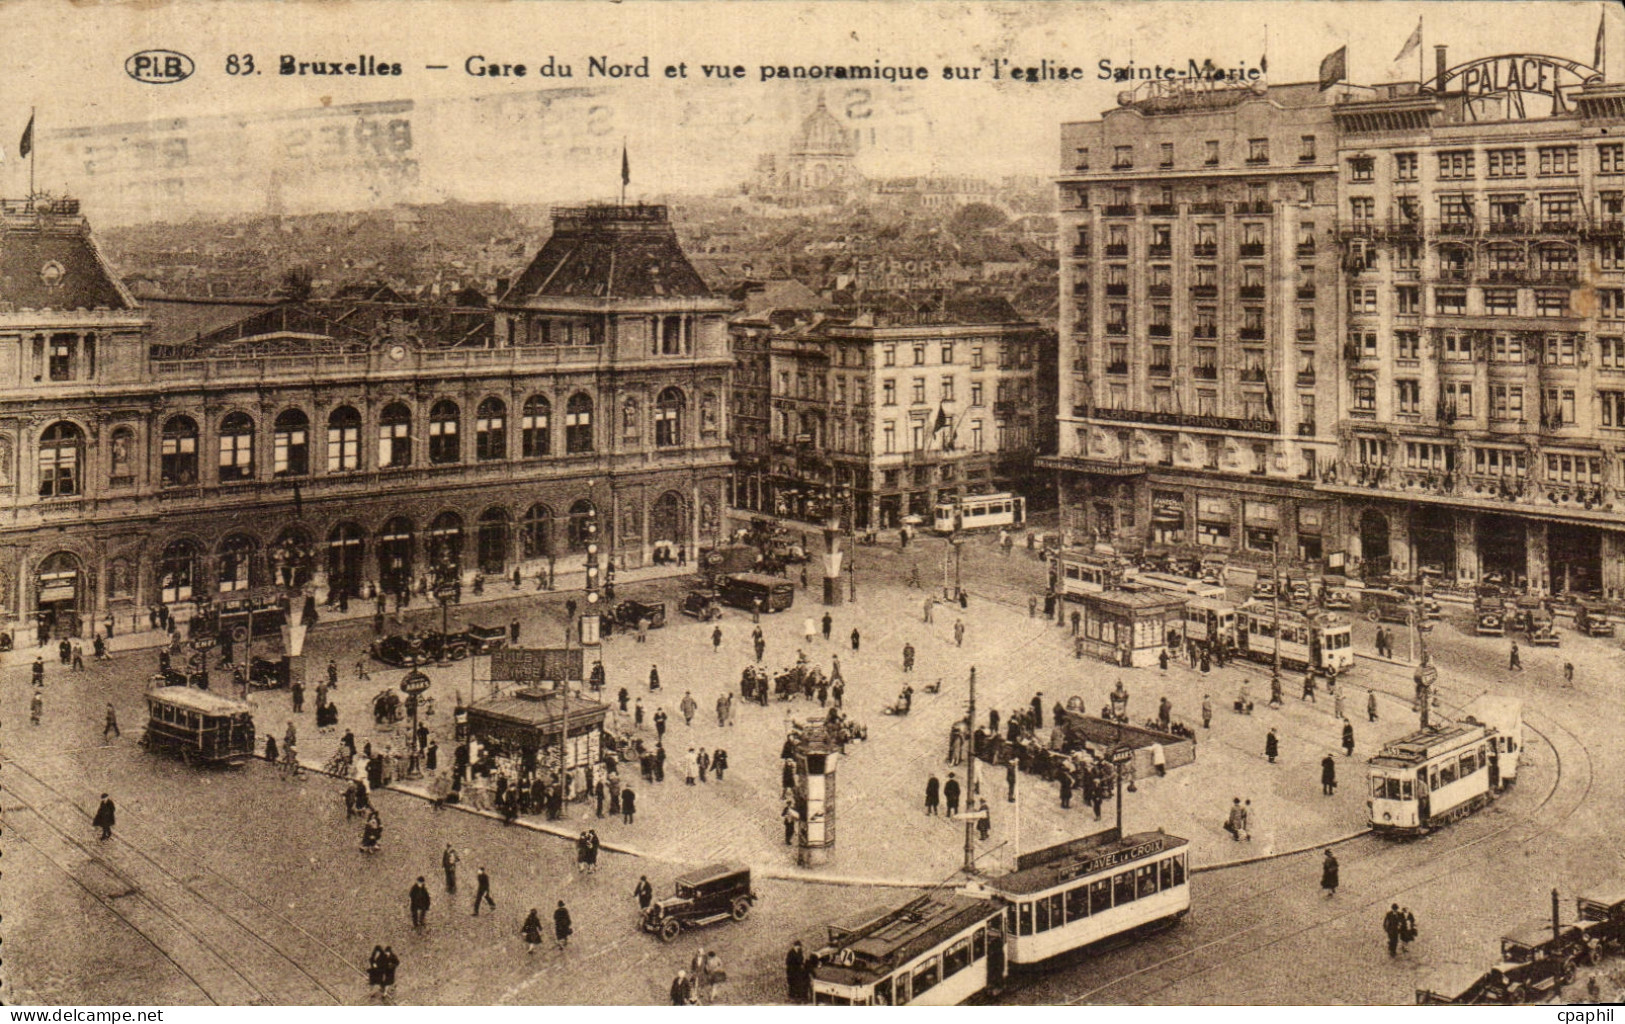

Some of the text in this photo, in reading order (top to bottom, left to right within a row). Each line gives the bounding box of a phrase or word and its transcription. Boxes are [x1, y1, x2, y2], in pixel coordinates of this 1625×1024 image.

[1465, 57, 1553, 96] PALACE
[1174, 414, 1230, 428] TERMINUS
[1238, 419, 1272, 433] NORD
[1086, 854, 1119, 873] JAVEL
[1130, 839, 1162, 859] CROIX
[842, 949, 853, 965] 74
